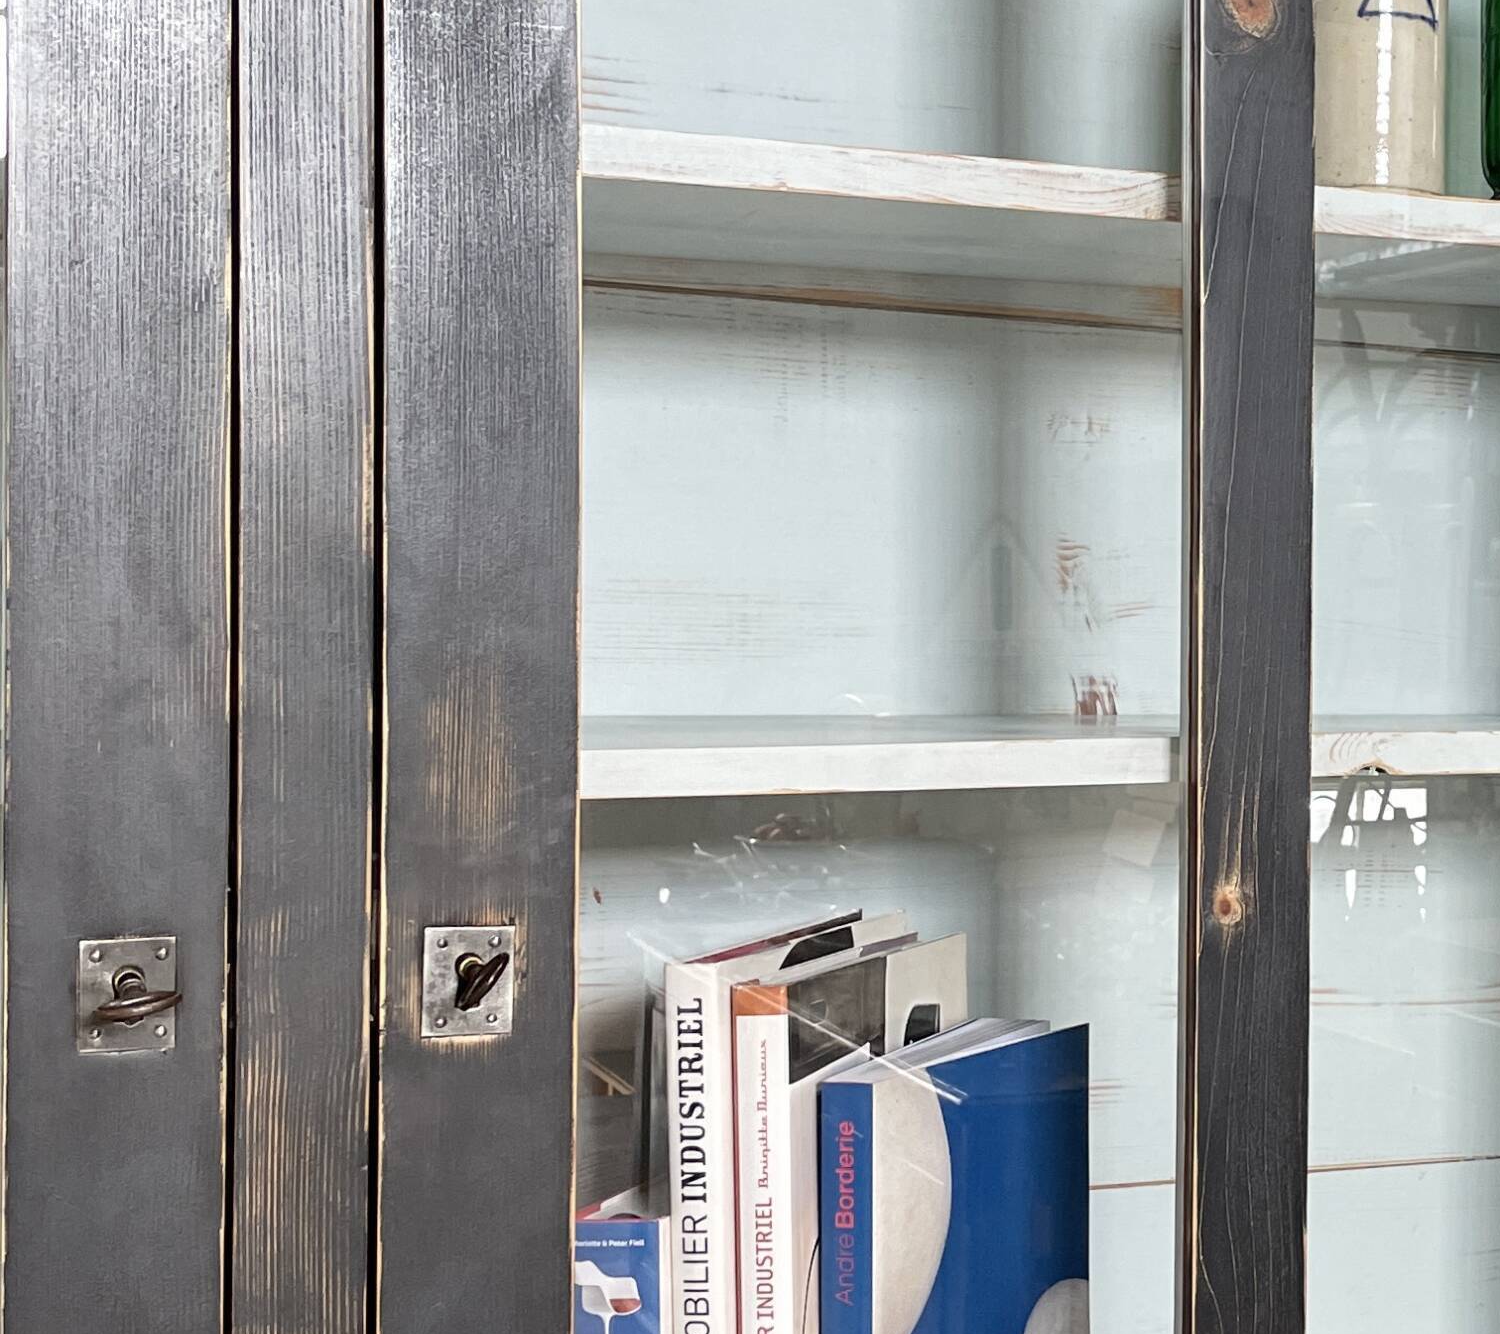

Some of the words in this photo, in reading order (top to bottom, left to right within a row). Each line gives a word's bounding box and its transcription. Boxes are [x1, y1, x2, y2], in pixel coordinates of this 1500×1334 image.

[677, 997, 707, 1203] INDUSTRIEL
[834, 1120, 855, 1229] Borderie
[754, 1197, 774, 1319] INDUSTRIEL
